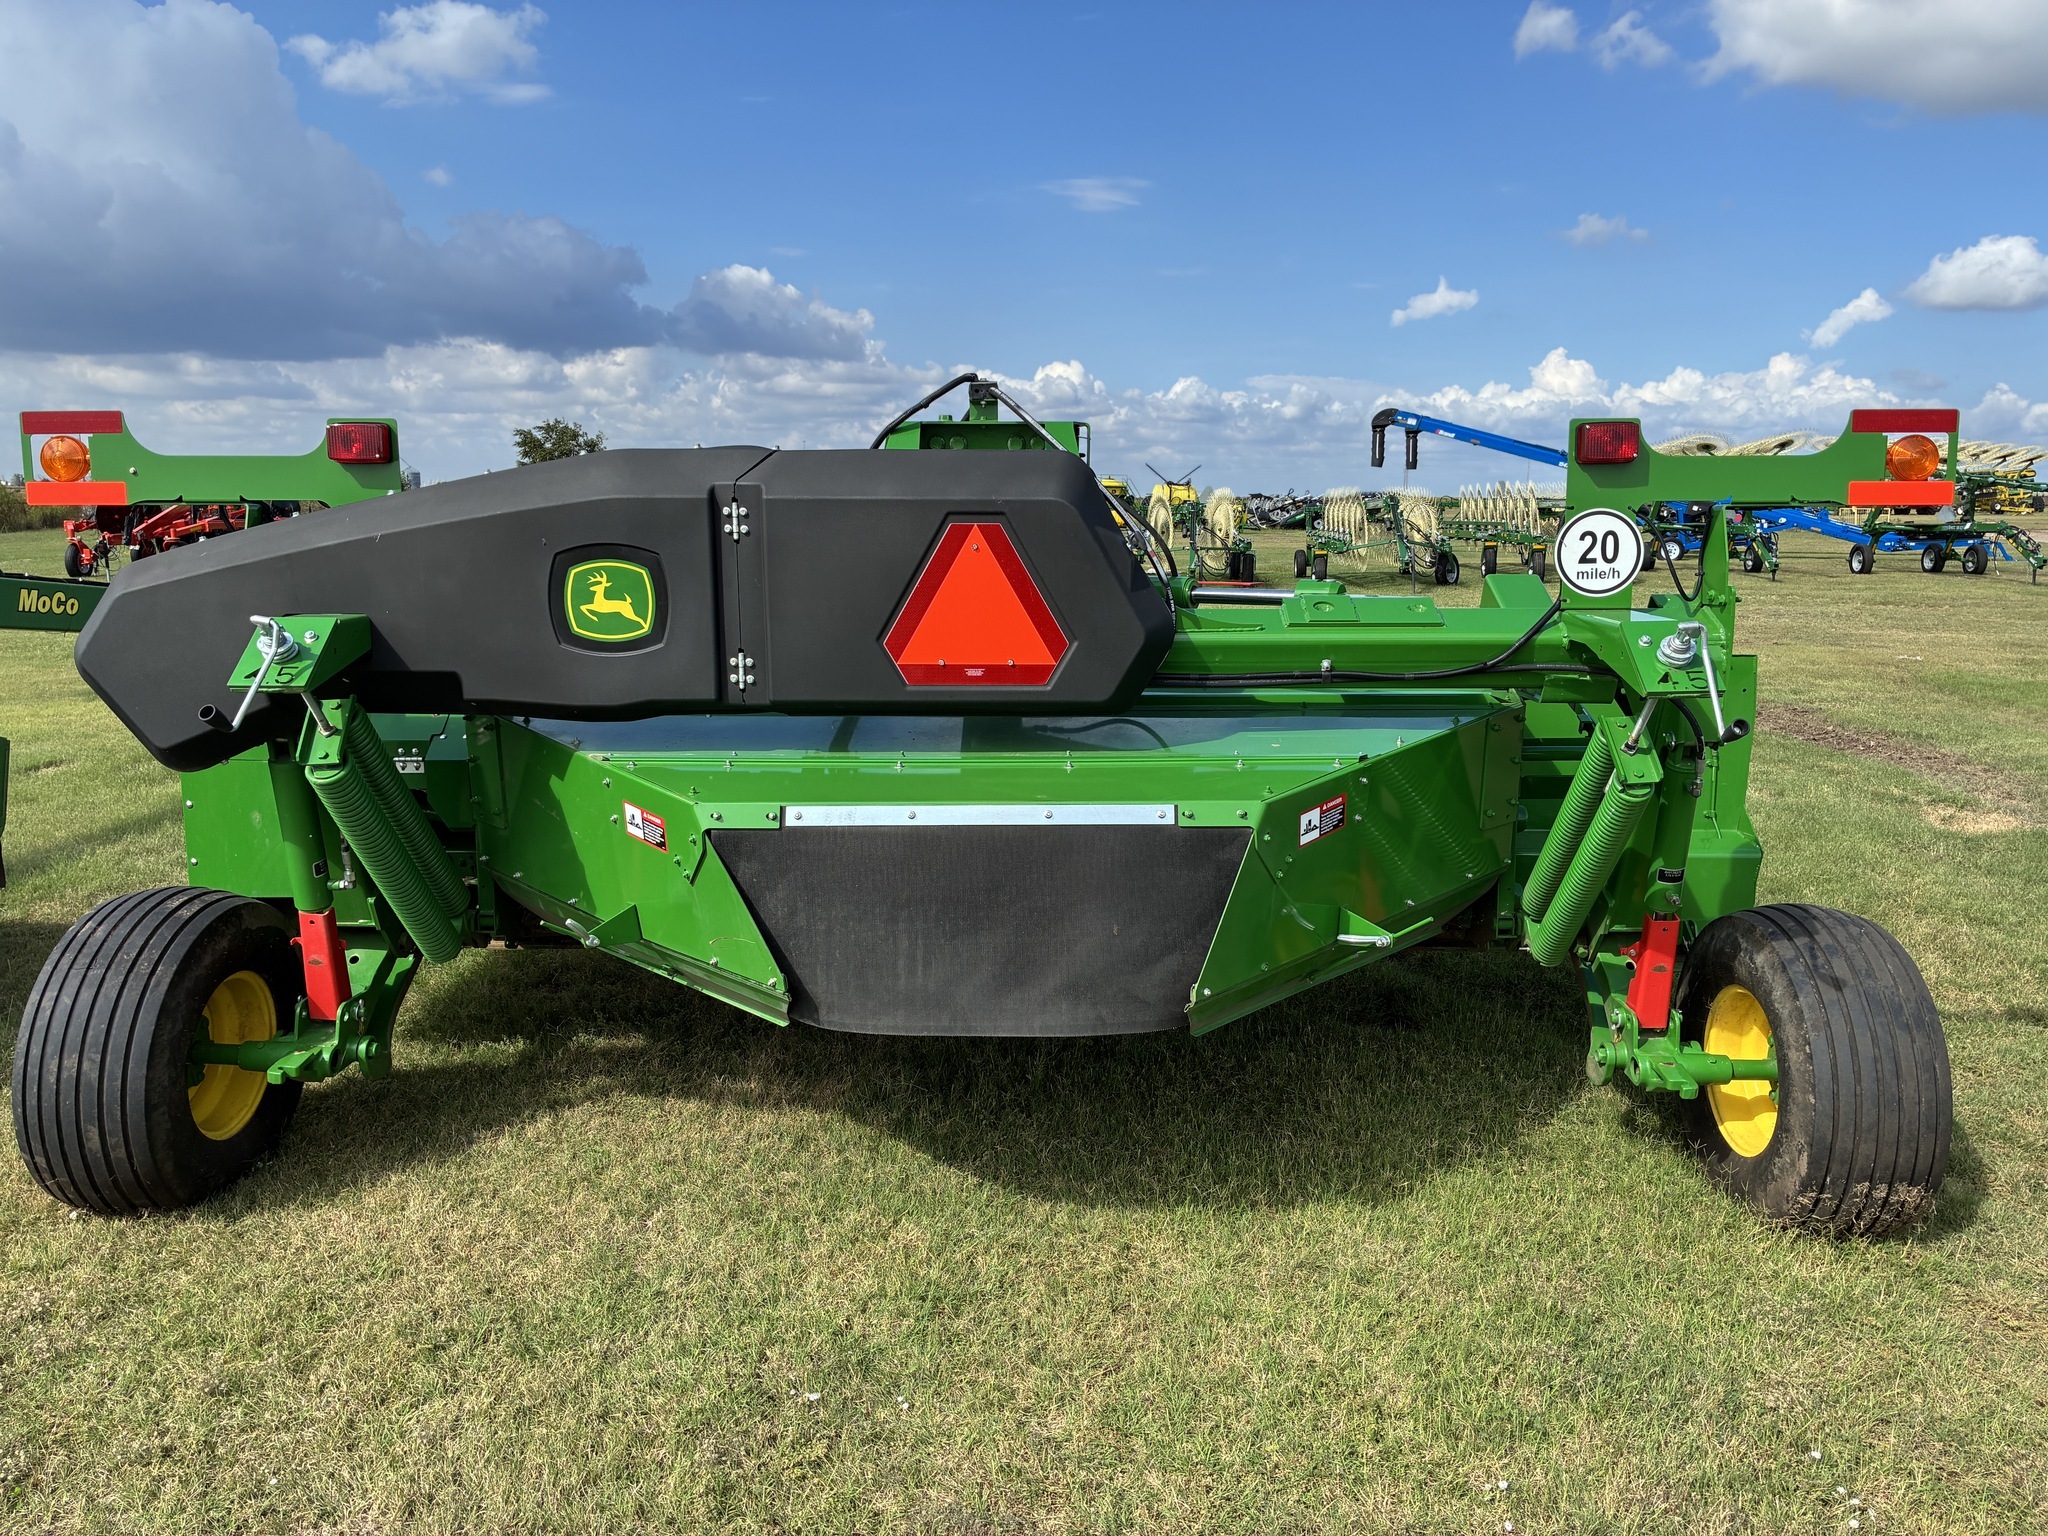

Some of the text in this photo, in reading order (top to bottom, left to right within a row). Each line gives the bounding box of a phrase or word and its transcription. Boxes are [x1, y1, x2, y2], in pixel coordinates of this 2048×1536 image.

[1578, 530, 1620, 564] 20
[1576, 567, 1620, 580] mile/h
[18, 588, 79, 615] MoCo
